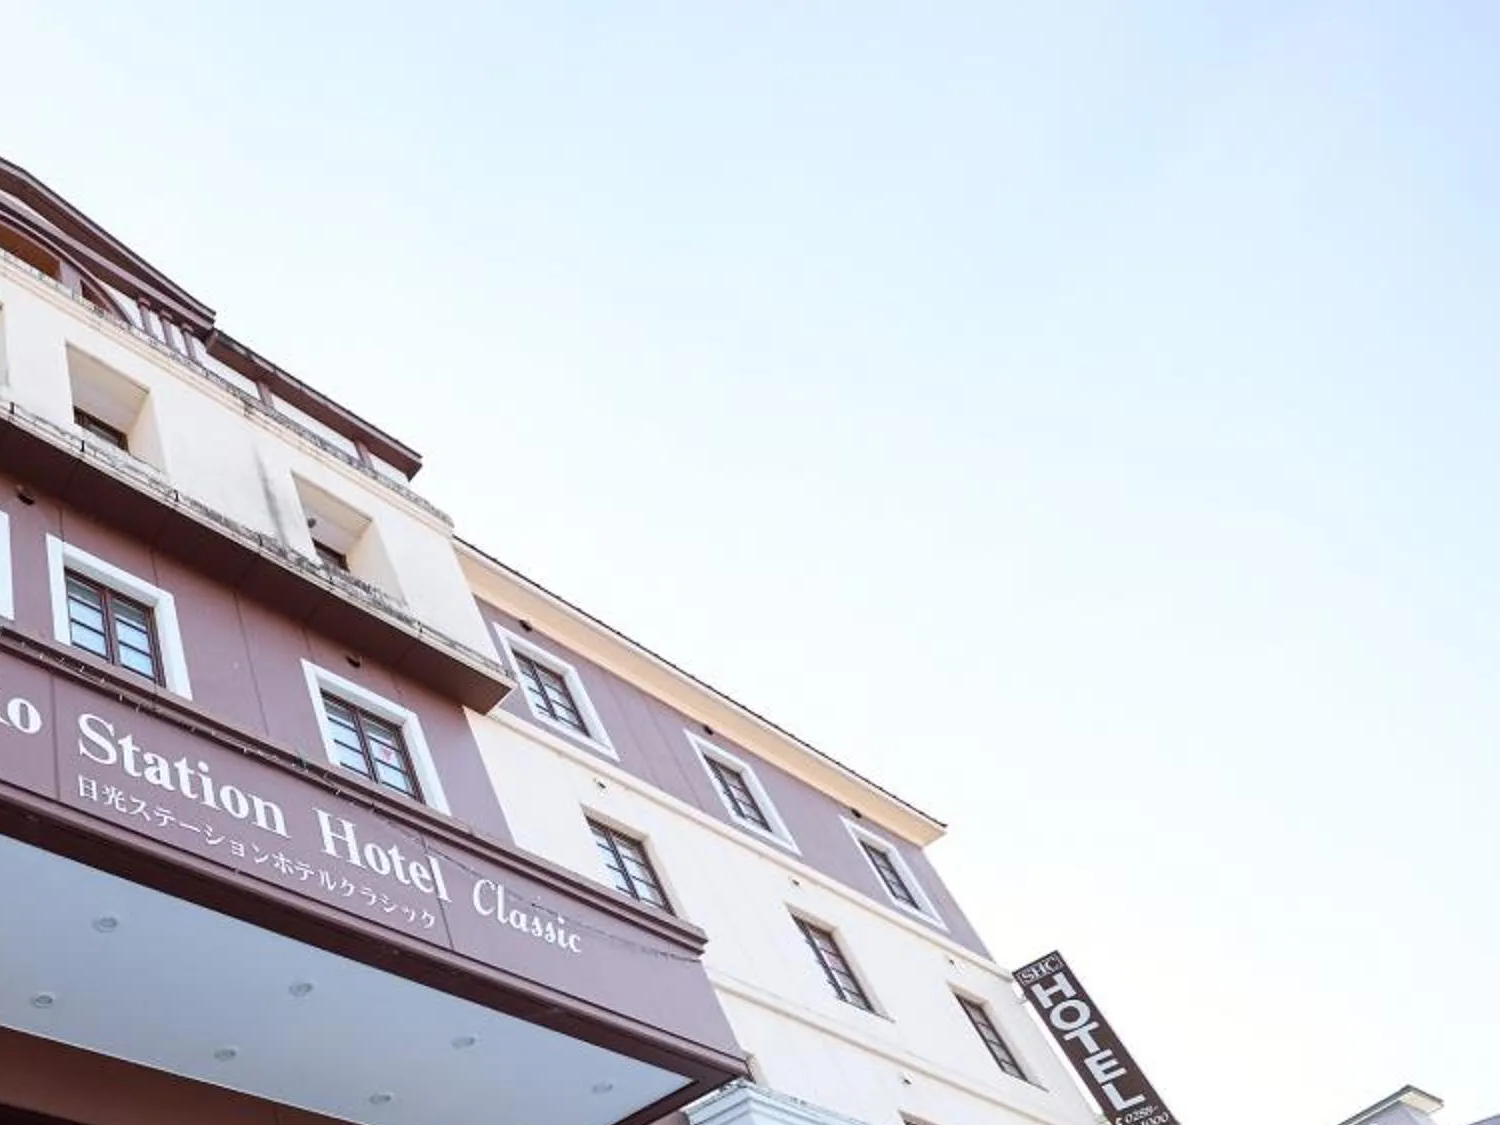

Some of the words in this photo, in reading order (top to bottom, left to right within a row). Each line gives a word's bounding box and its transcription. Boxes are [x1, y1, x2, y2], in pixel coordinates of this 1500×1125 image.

[77, 713, 292, 840] Station
[312, 807, 453, 903] Hotel
[473, 878, 583, 953] Classic
[77, 774, 436, 929] 日光ステーションホテルクラシック
[1030, 971, 1146, 1111] HOTEL
